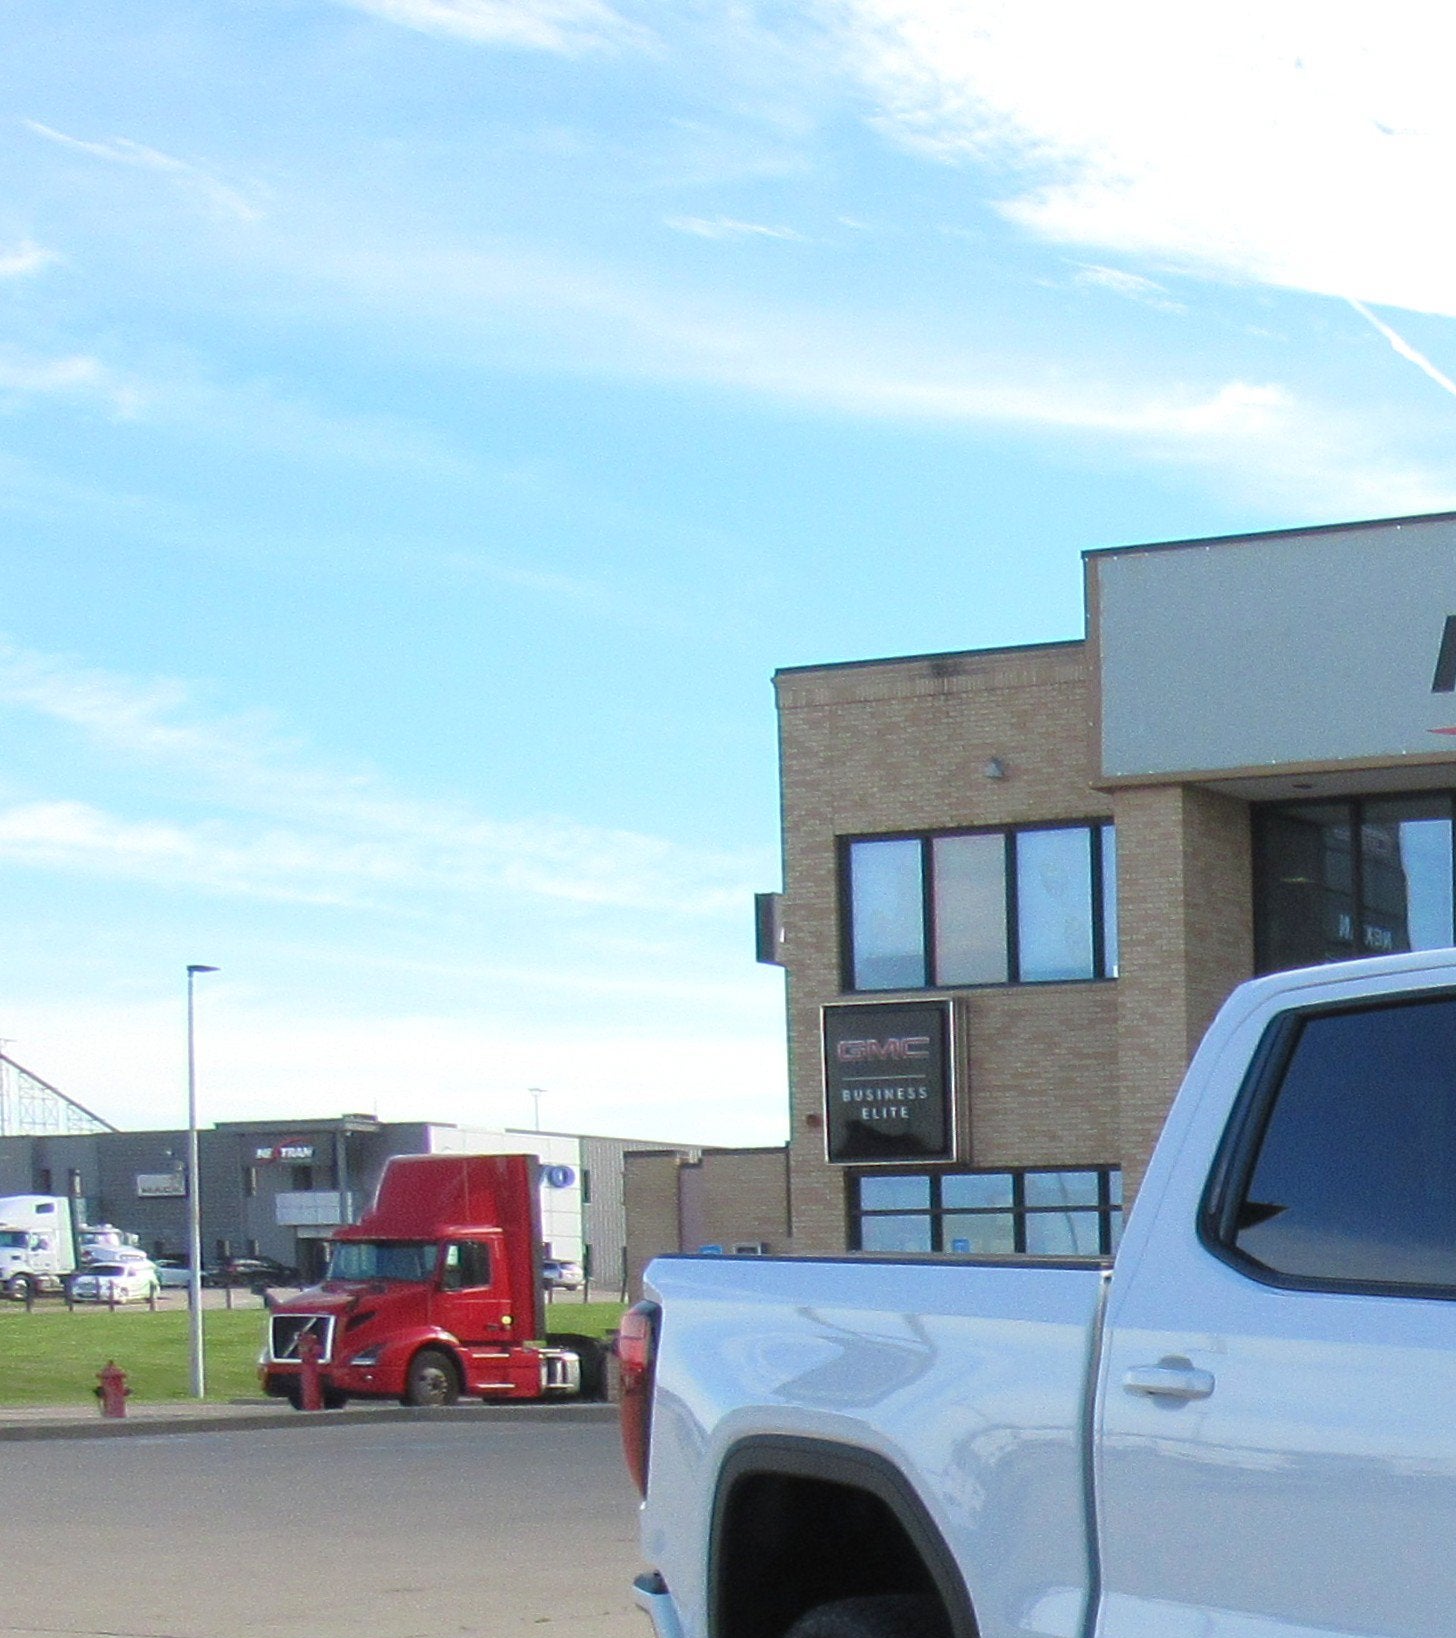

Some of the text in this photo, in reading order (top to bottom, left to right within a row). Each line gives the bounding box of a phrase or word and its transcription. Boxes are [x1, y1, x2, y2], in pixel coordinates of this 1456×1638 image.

[837, 1036, 930, 1063] GMC
[842, 1086, 928, 1102] BUSINESS
[862, 1106, 910, 1120] ELITE
